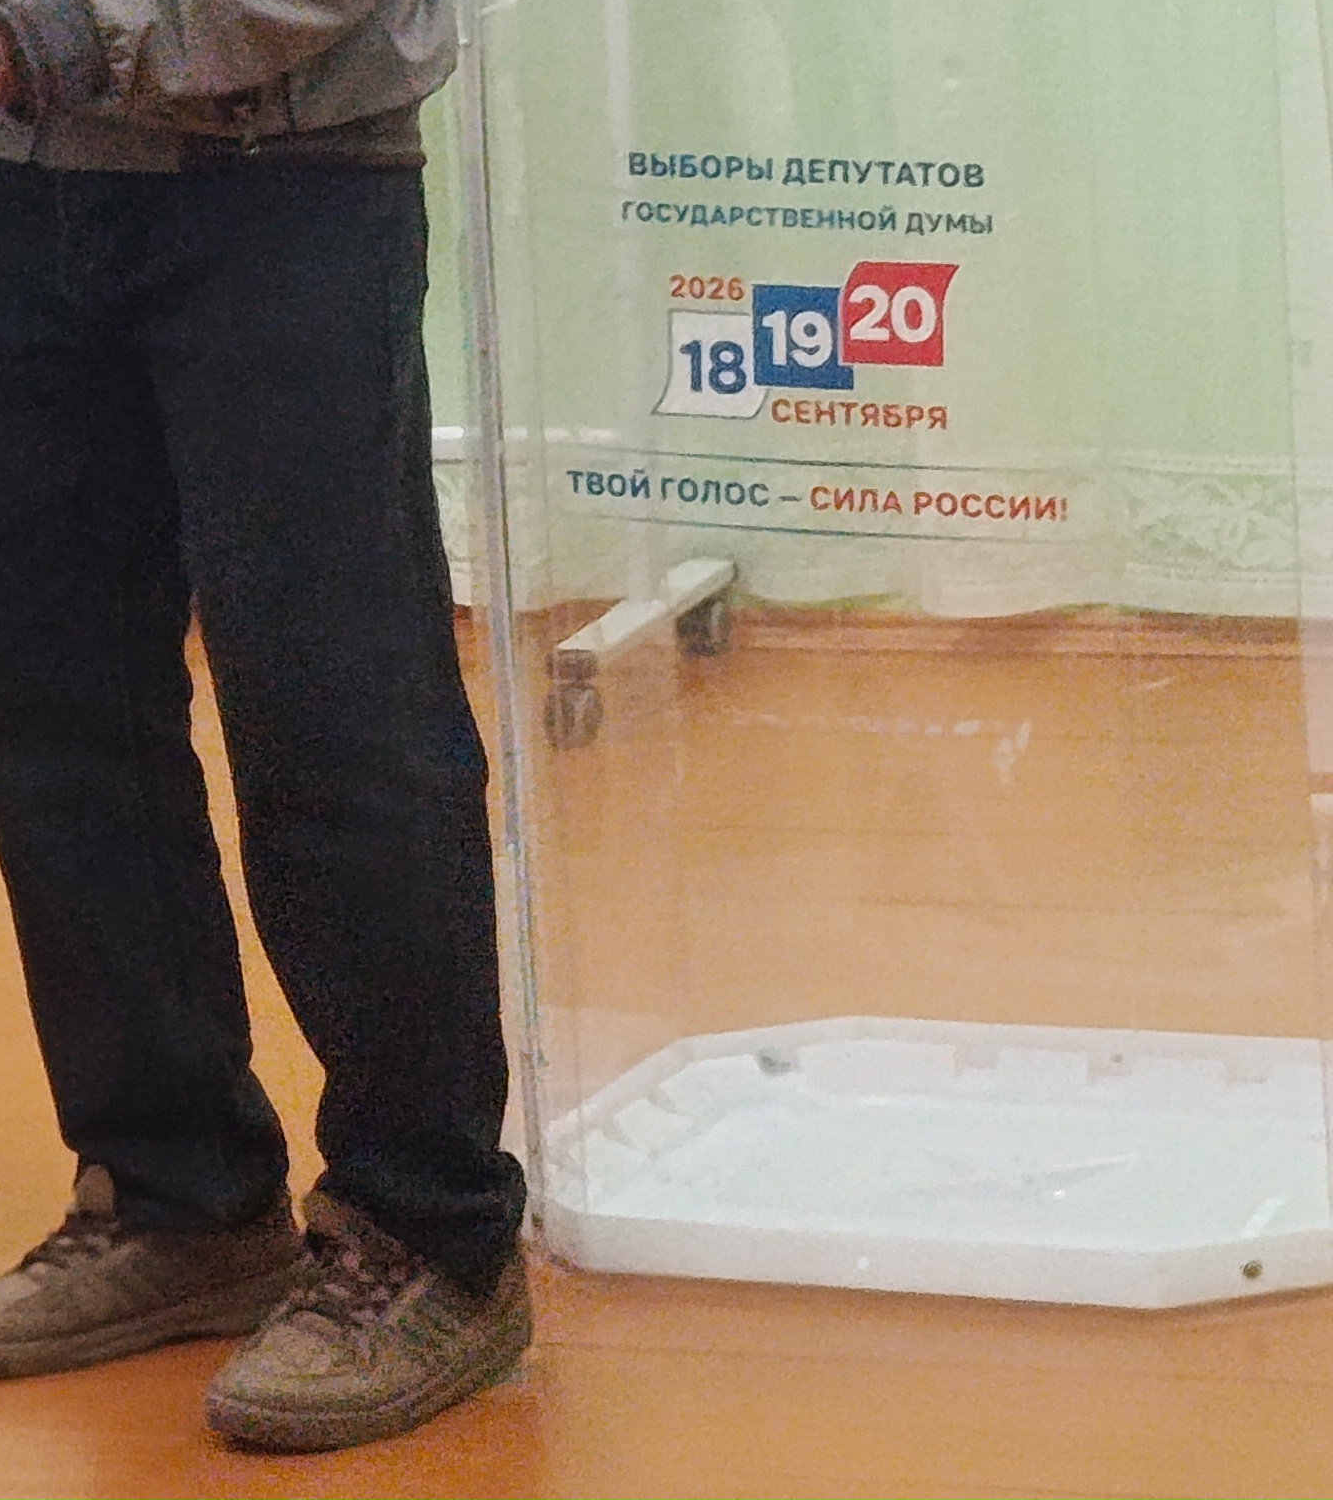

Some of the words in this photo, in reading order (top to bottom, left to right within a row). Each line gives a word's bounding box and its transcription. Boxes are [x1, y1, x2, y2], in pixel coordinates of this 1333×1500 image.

[628, 151, 774, 182] ВЫБОРЫ
[782, 158, 986, 189] ДЕПУТАТОВ
[621, 200, 897, 233] ГОСУДАРСТВЕННОЙ
[905, 211, 994, 237] ДУМЫ
[669, 274, 745, 302] 2026
[679, 339, 748, 396] 18
[762, 309, 834, 369] 19
[849, 284, 937, 344] 20
[770, 399, 948, 430] СЕНТЯБРЯ
[566, 468, 650, 500] ТВОЙ
[659, 477, 770, 507] ГОЛОС
[810, 485, 902, 516] СИЛА
[914, 491, 1068, 522] РОССИИ!
